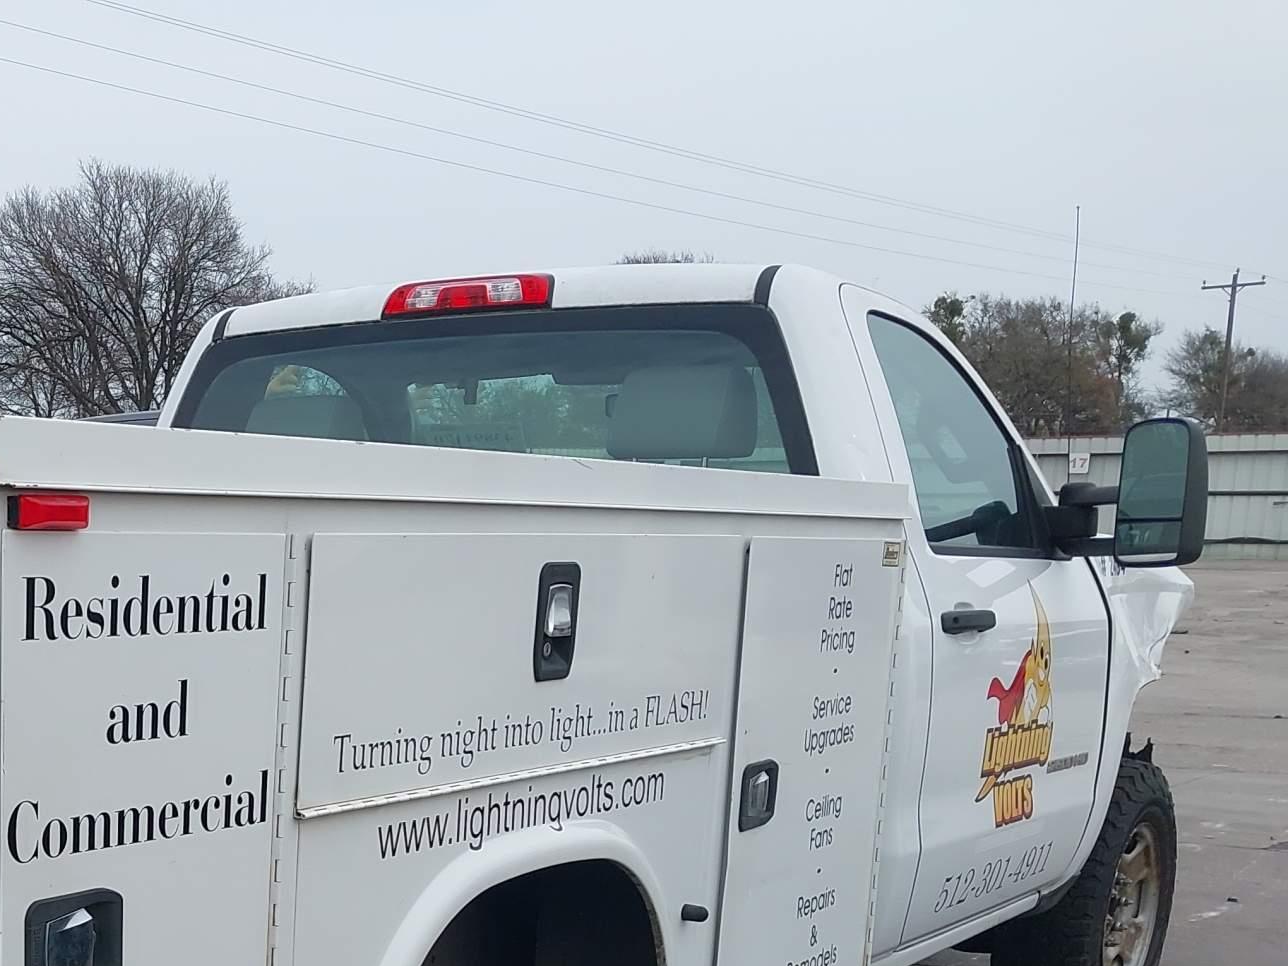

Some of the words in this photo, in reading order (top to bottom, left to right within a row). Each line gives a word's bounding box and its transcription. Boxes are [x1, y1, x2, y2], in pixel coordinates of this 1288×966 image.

[1070, 457, 1089, 469] 17
[834, 563, 853, 588] Flat
[21, 573, 269, 642] Residential
[828, 595, 853, 620] Rate
[820, 626, 855, 654] Pricing
[106, 679, 190, 745] and
[812, 693, 852, 720] Service
[333, 728, 433, 775] Turning
[440, 716, 498, 769] night
[504, 714, 543, 748] into
[629, 705, 639, 730] a
[645, 690, 709, 728] FLASH!
[804, 722, 855, 756] Upgrades
[981, 719, 1053, 779] Lightning
[7, 769, 271, 865] Commercial
[378, 771, 665, 860] www.lightningvolts.com
[806, 793, 842, 822] Ceiling
[993, 774, 1034, 828] VOLTS
[810, 827, 833, 850] Fans
[934, 841, 1054, 913] 512-301-4911
[797, 888, 836, 919] Repairs
[810, 925, 818, 947] &
